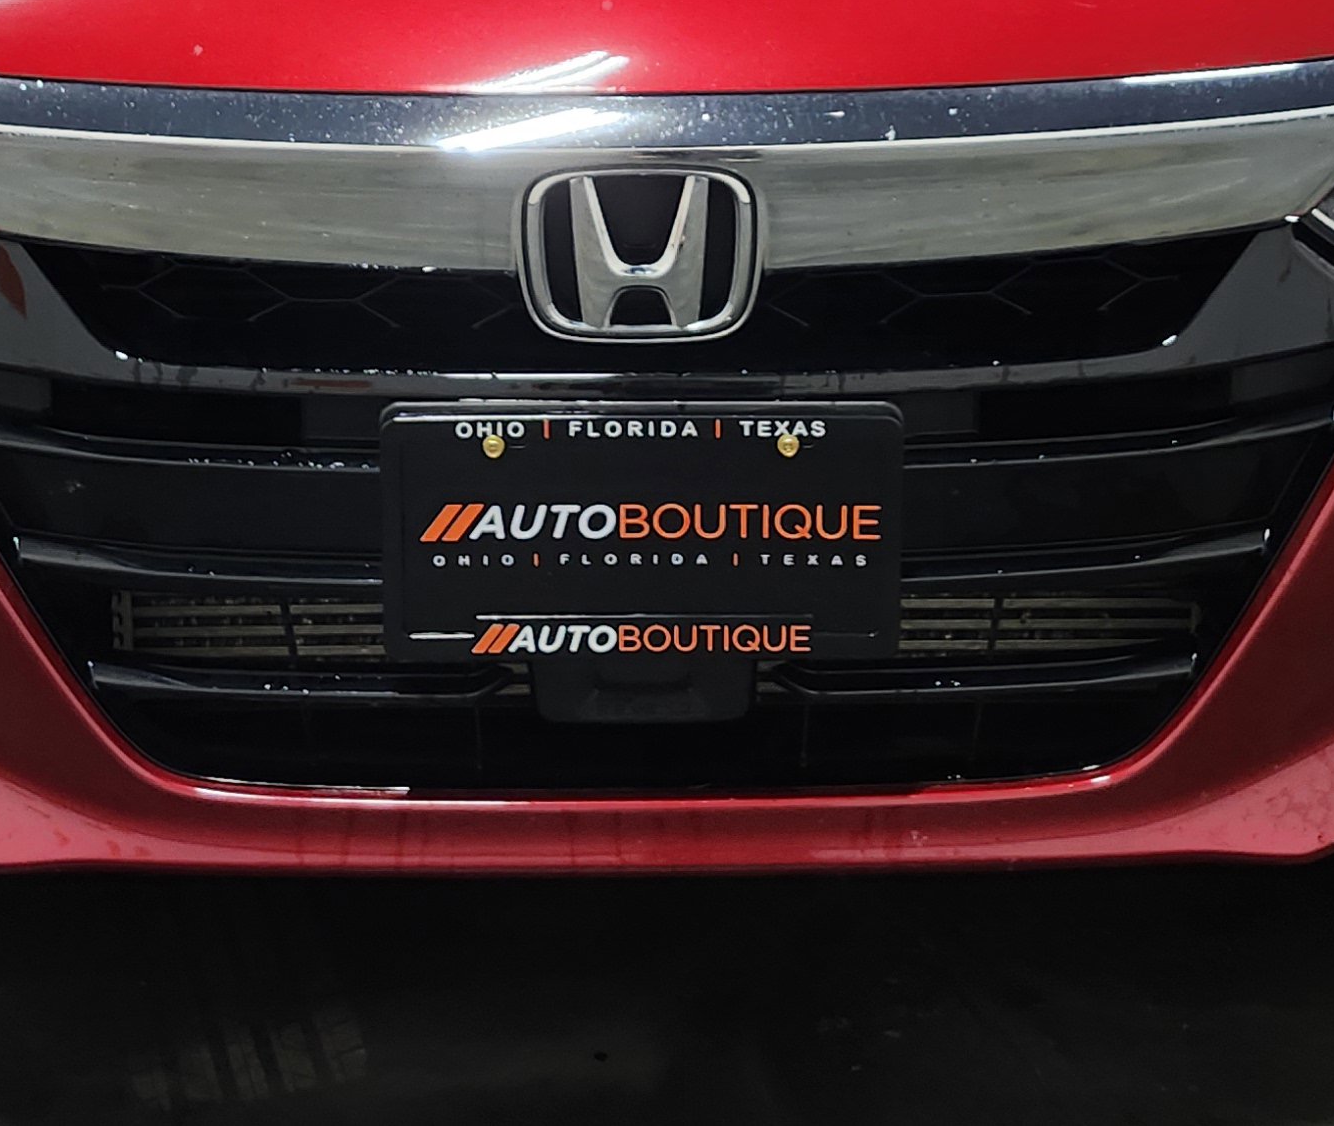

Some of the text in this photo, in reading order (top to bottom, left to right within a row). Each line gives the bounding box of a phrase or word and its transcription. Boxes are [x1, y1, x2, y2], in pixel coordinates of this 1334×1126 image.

[455, 420, 827, 439] OHIO FLORIDA TEXAS
[469, 503, 882, 543] AUTOBOUTIQUE
[432, 553, 868, 567] OHIO FLORIDA TEXAS
[507, 623, 813, 654] AUTOBOUTIQUE
